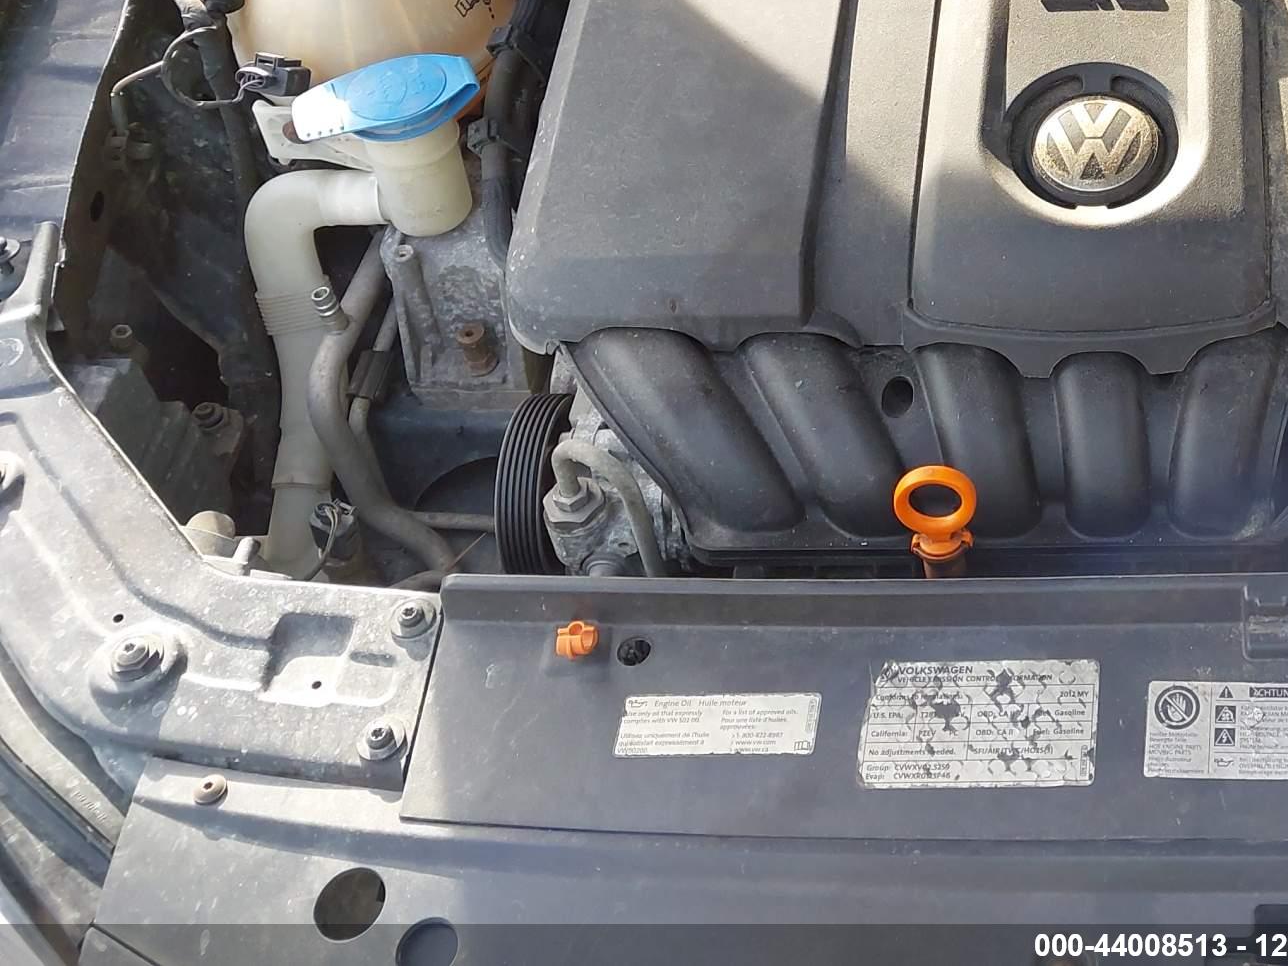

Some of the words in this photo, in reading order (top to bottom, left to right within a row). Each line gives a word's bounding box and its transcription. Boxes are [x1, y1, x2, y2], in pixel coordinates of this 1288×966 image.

[899, 665, 974, 675] VOLKSWAGEN
[965, 674, 997, 682] CONTRO
[1059, 689, 1076, 698] 2012
[1077, 689, 1090, 697] MY
[655, 700, 680, 709] Engine
[698, 699, 718, 707] Huile
[720, 699, 747, 707] moteur
[873, 711, 887, 719] U.S.
[1055, 708, 1086, 716] Gasoline
[871, 730, 908, 738] California:
[976, 728, 995, 736] OBD:
[996, 728, 1007, 736] CA
[1053, 727, 1084, 735] Gasoline
[868, 748, 879, 756] No
[881, 747, 926, 757] adjustments
[865, 773, 885, 782] Evap:
